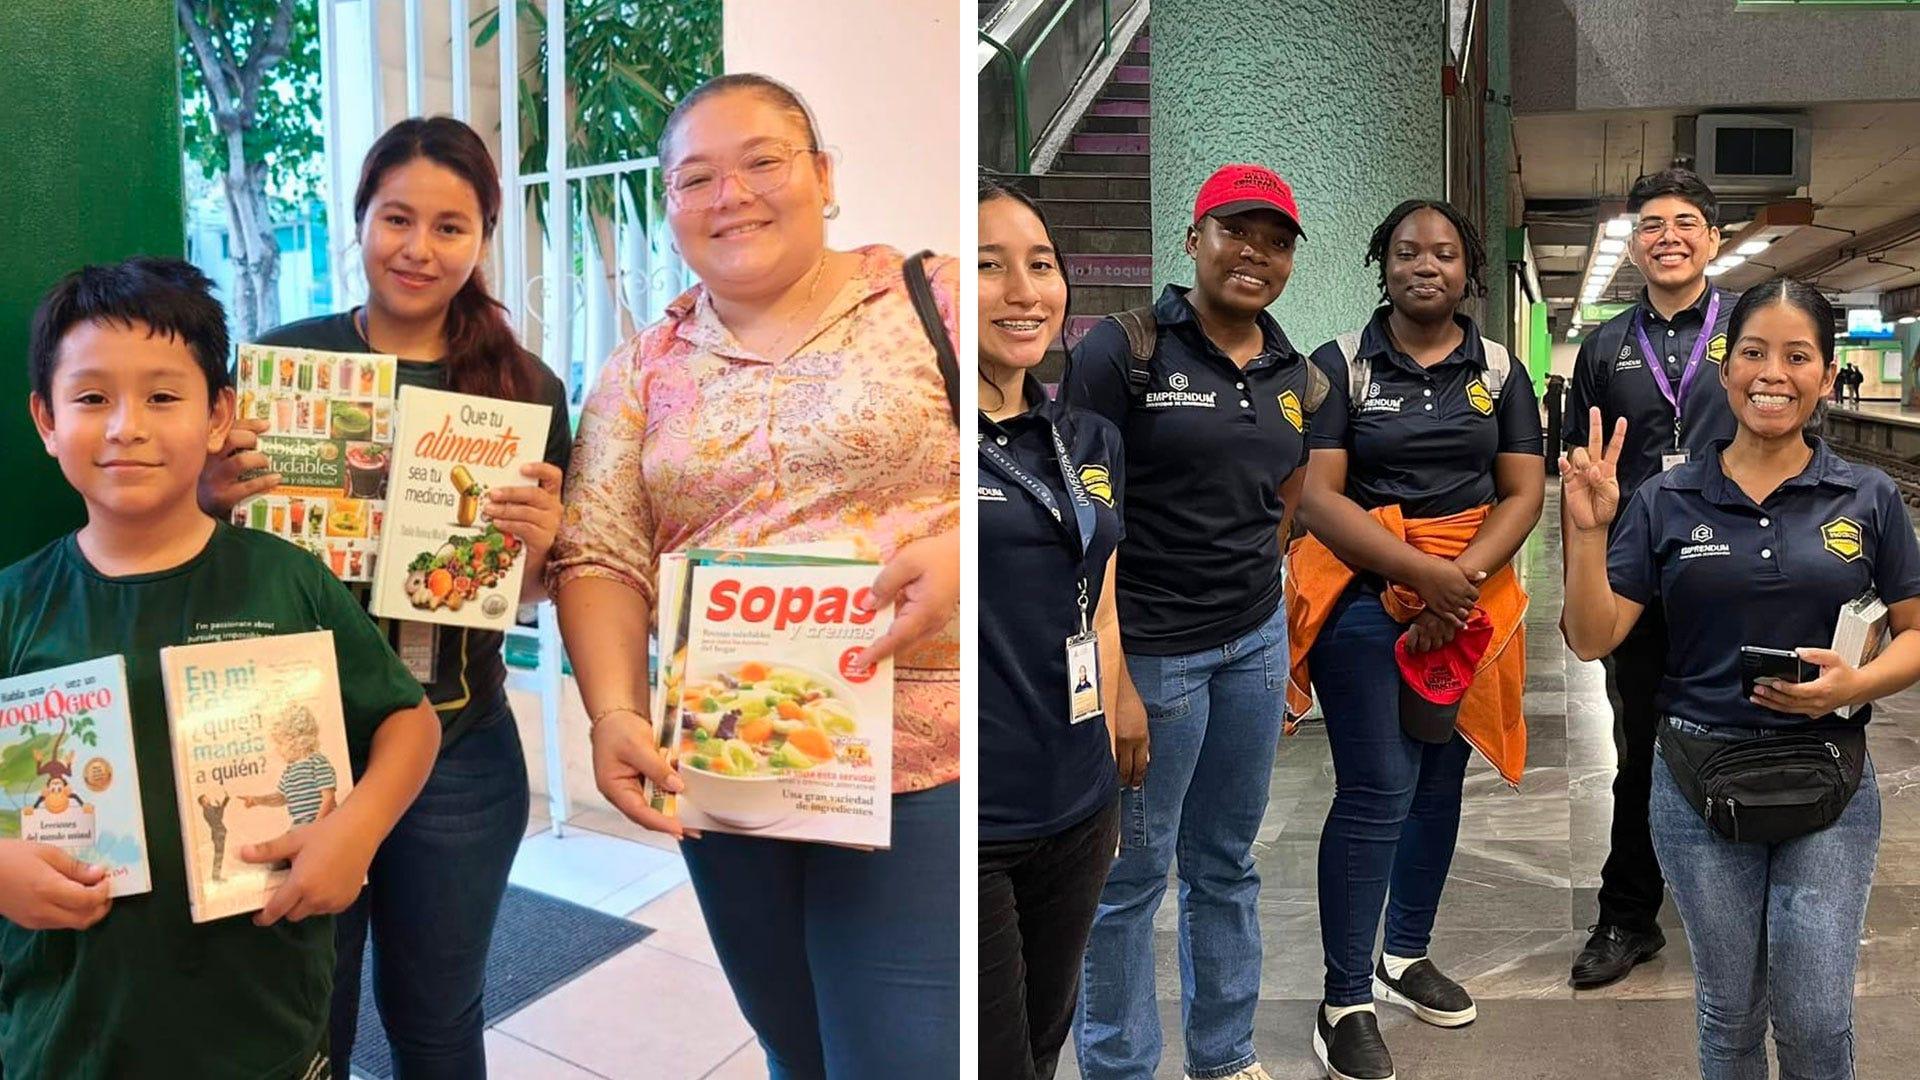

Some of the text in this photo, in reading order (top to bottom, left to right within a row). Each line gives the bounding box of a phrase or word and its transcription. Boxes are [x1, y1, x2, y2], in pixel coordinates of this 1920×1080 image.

[1146, 391, 1216, 403] EMPRENDUM
[460, 404, 504, 428] Que tu
[414, 415, 521, 468] alimento
[268, 454, 339, 476] ludables
[408, 465, 442, 483] sea tu
[405, 486, 455, 507] medicina
[185, 658, 257, 692] En mi
[193, 734, 266, 762] manda
[196, 755, 268, 786] a quién?
[804, 792, 828, 803] gran
[829, 794, 874, 806] variedad
[810, 803, 874, 816] ingredientes
